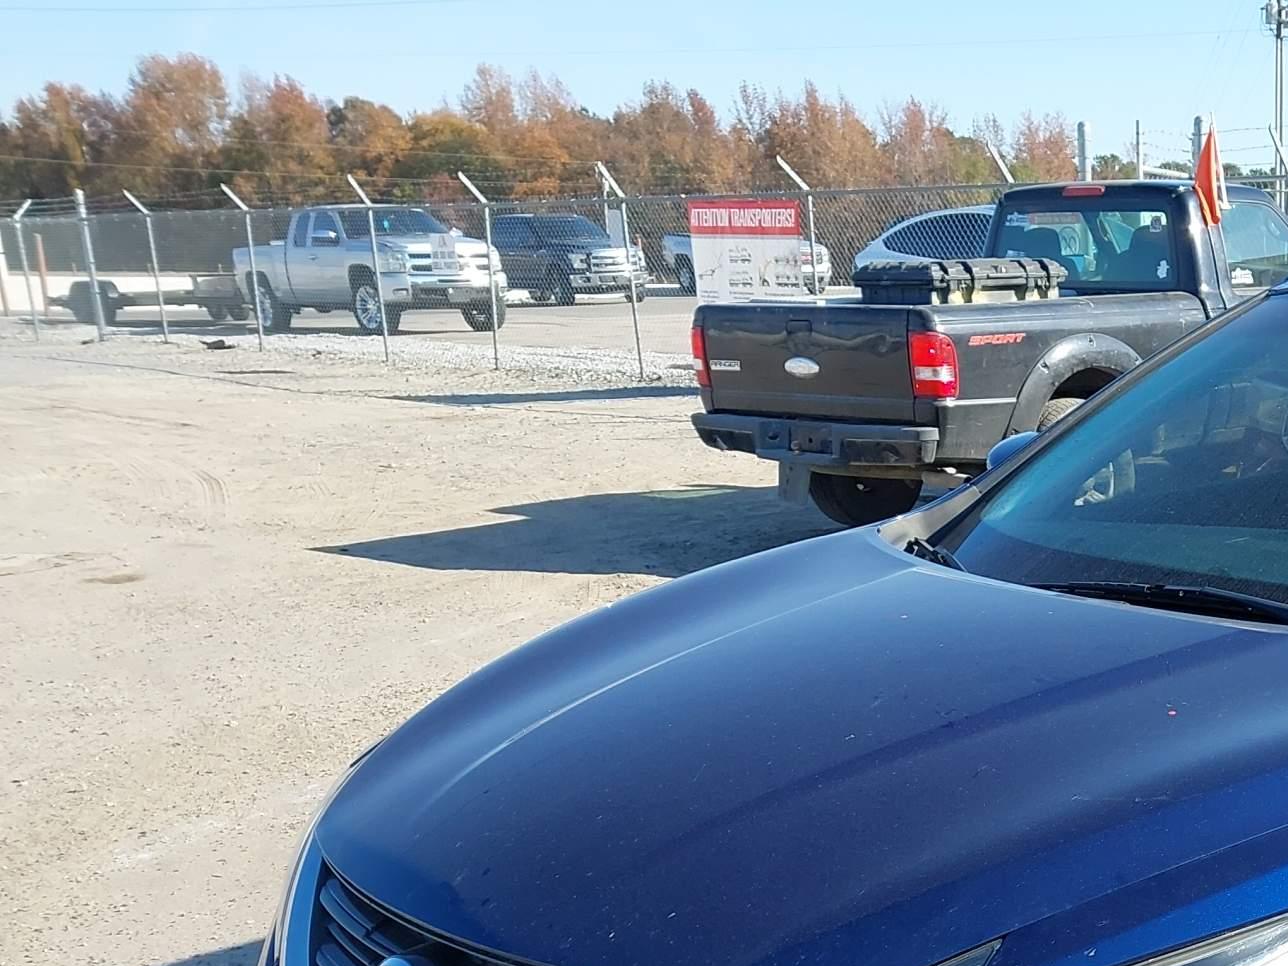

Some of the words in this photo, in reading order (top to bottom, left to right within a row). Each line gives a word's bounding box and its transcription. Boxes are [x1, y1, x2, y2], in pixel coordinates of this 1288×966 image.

[691, 208, 729, 227] ATTENTION
[730, 208, 795, 227] TRANSPORTERS!
[968, 333, 1026, 346] SPORT
